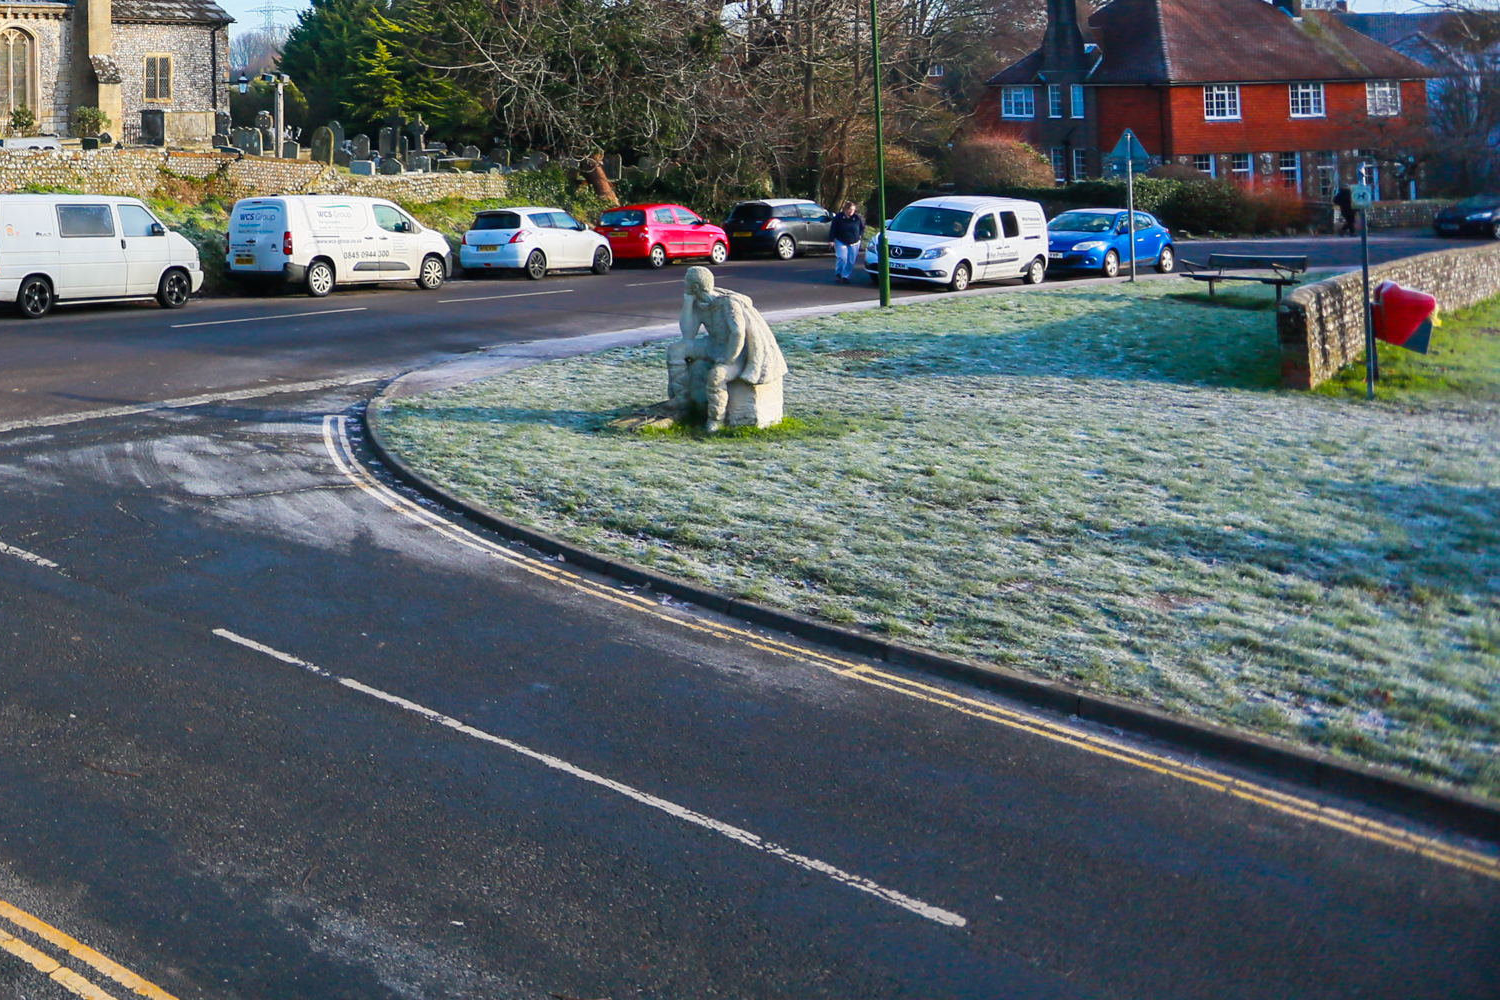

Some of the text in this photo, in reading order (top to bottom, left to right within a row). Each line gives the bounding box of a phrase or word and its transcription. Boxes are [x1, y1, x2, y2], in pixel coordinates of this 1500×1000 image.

[240, 213, 276, 222] WCS Group
[316, 210, 352, 219] WCS Group
[343, 250, 390, 259] 0845 0944 300
